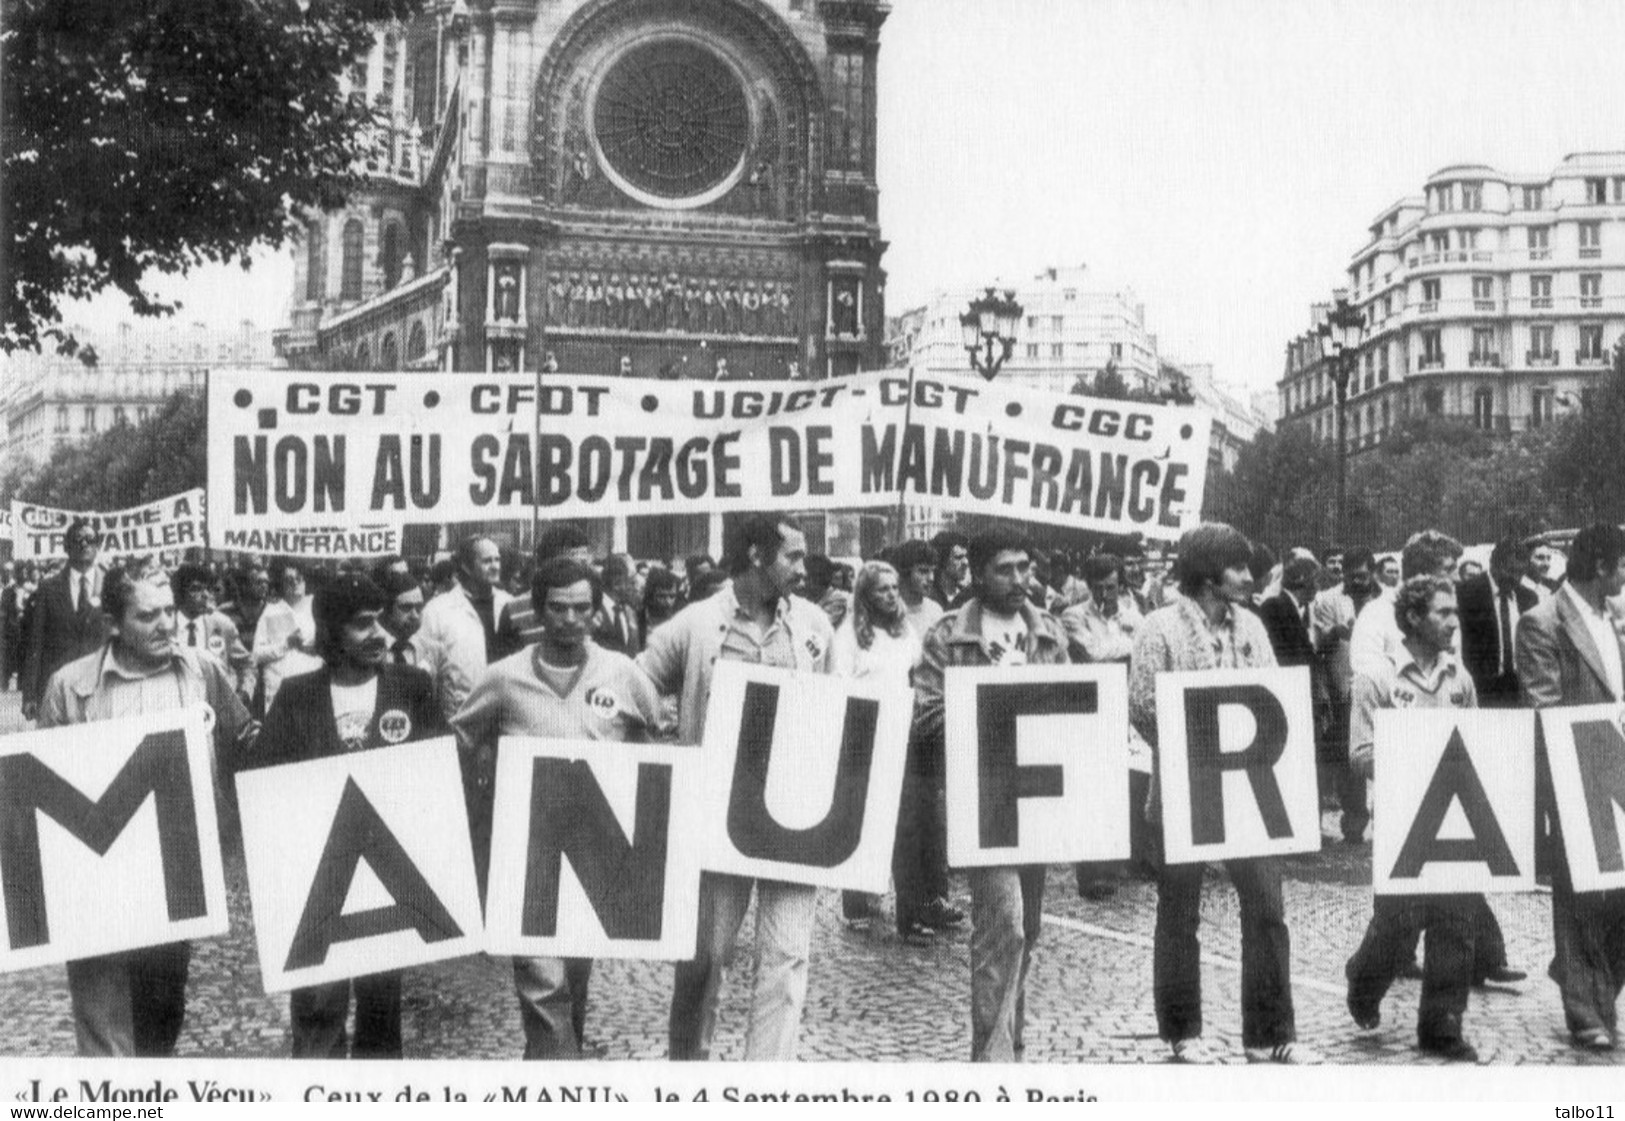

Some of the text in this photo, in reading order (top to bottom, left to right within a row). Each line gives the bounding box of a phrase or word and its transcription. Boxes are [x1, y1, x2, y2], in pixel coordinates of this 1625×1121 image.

[286, 383, 397, 416] CGT
[470, 384, 610, 416] CFDT
[1052, 403, 1154, 442] CGC
[234, 423, 1189, 528] NON AU SABOTAGE DE MANUFRANCE
[27, 521, 196, 556] TRAILLER
[224, 529, 396, 554] MANUFRANCE
